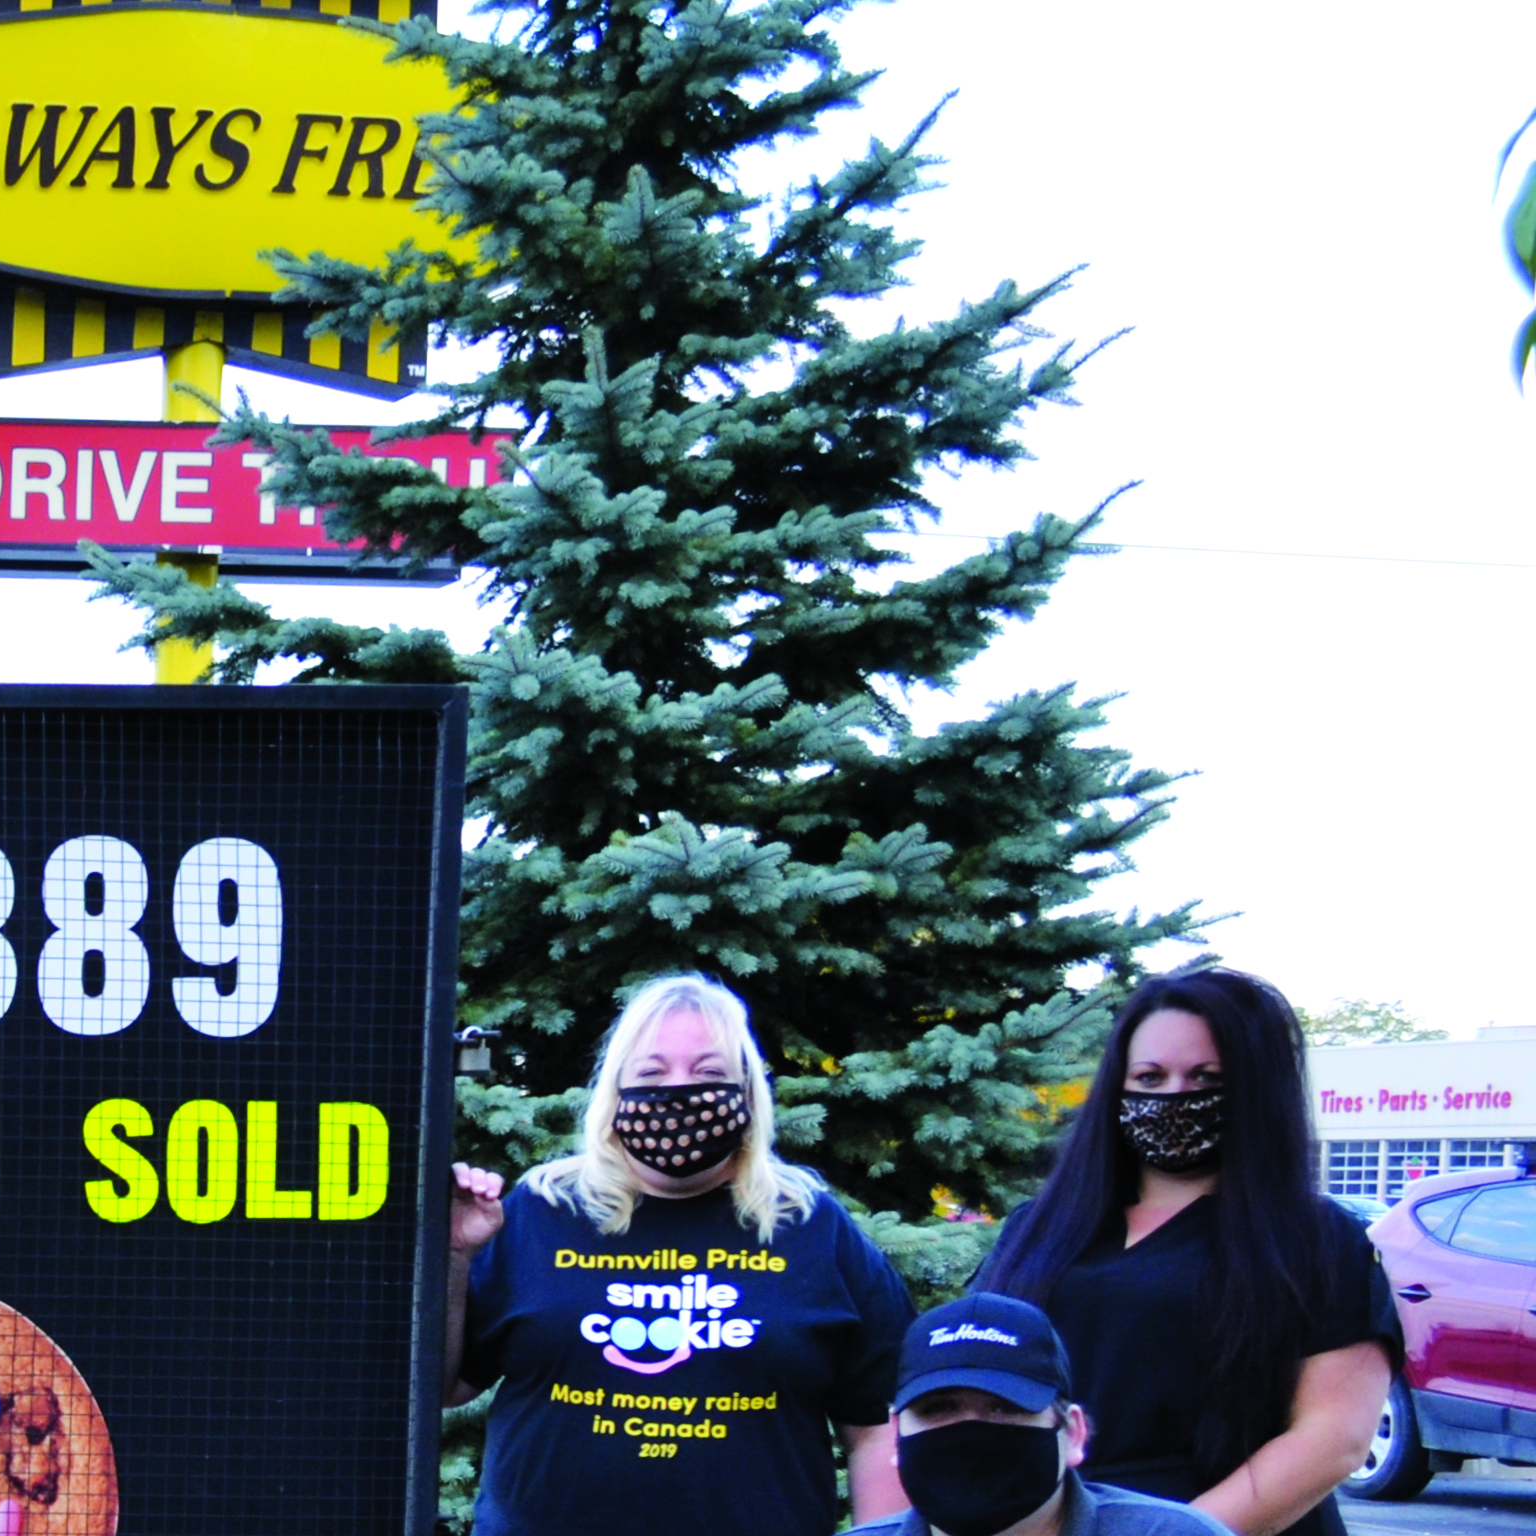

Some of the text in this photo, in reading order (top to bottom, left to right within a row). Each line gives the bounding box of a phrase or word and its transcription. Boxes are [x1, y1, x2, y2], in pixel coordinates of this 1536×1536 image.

[407, 364, 426, 377] TM
[1320, 1084, 1512, 1114] Tires Parts Service
[82, 1098, 390, 1224] SOLD
[555, 1248, 787, 1272] Dunnville Pride
[606, 1274, 739, 1310] smile
[580, 1309, 755, 1351] cookie
[550, 1383, 777, 1416] Most money raised
[592, 1415, 727, 1439] in Canada
[638, 1443, 678, 1458] 2019
